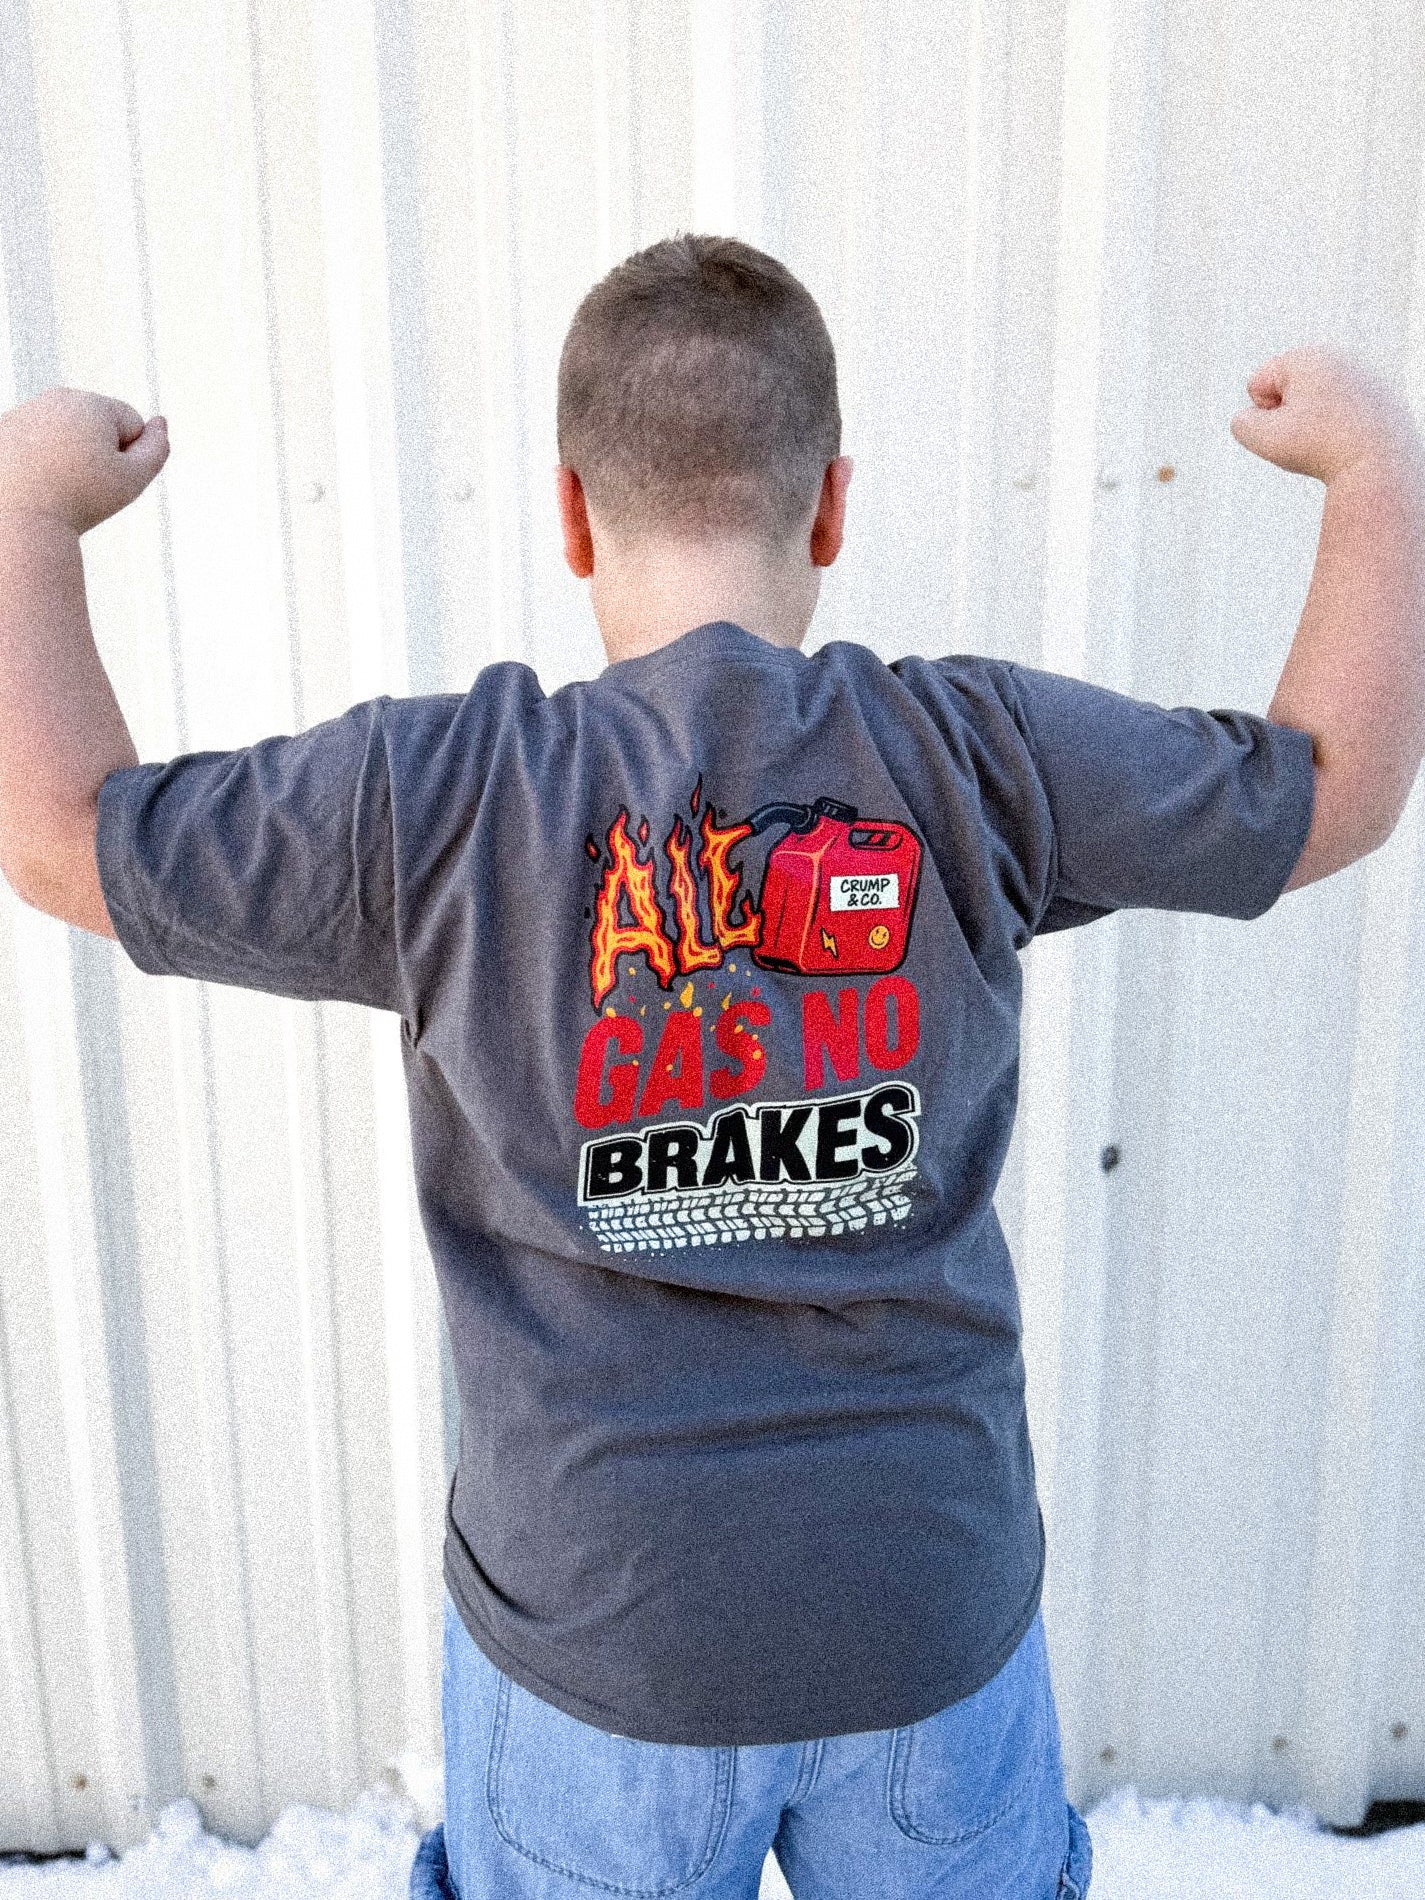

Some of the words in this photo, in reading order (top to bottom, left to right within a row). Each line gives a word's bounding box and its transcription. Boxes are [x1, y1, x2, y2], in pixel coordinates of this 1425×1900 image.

[592, 805, 761, 1011] ALL
[840, 877, 891, 893] CRUMP
[576, 1002, 771, 1128] GAS
[802, 976, 921, 1089] NO
[584, 1085, 918, 1201] BRAKES
